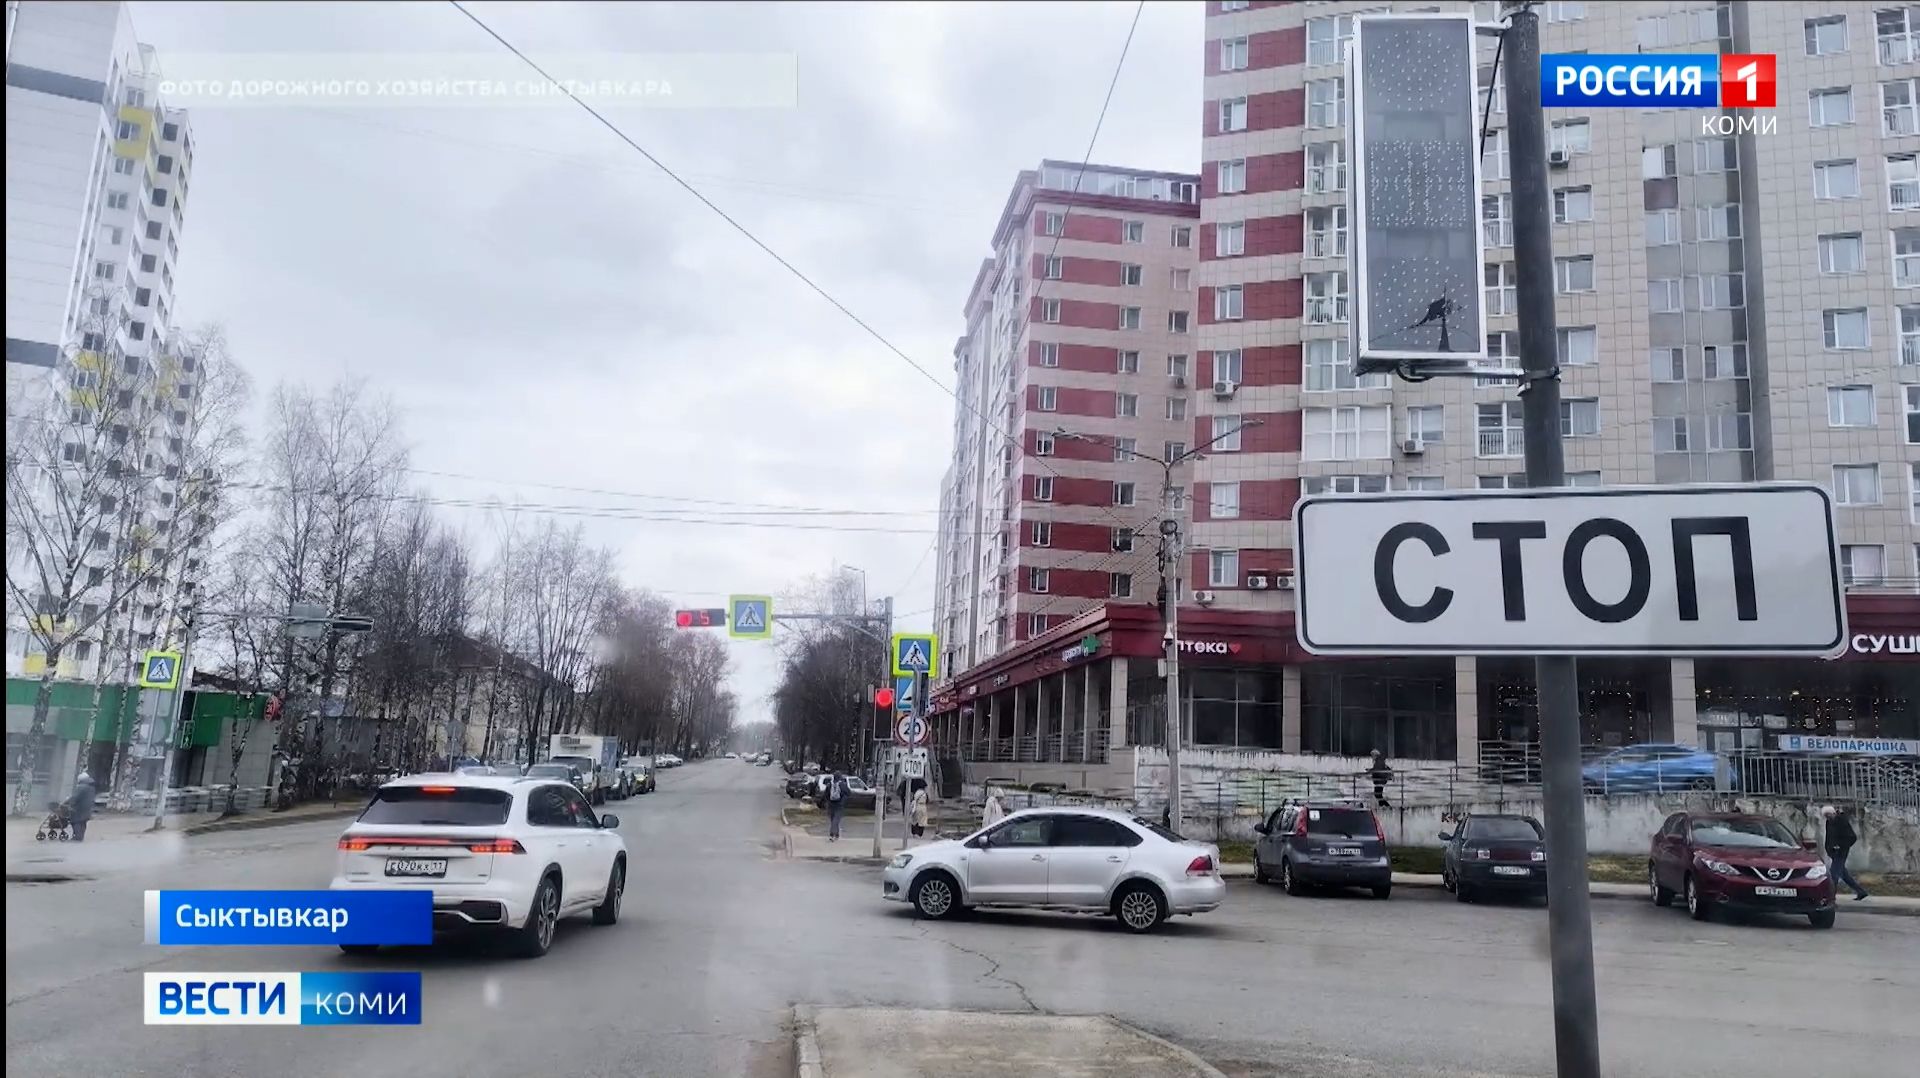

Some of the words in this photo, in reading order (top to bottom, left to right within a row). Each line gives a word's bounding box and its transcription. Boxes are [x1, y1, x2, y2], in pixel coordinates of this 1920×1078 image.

[1374, 516, 1758, 623] СТОП
[1852, 634, 1920, 653] СУШ
[904, 721, 921, 735] 20
[1807, 737, 1908, 752] ВЕЛОПАРКОВКА
